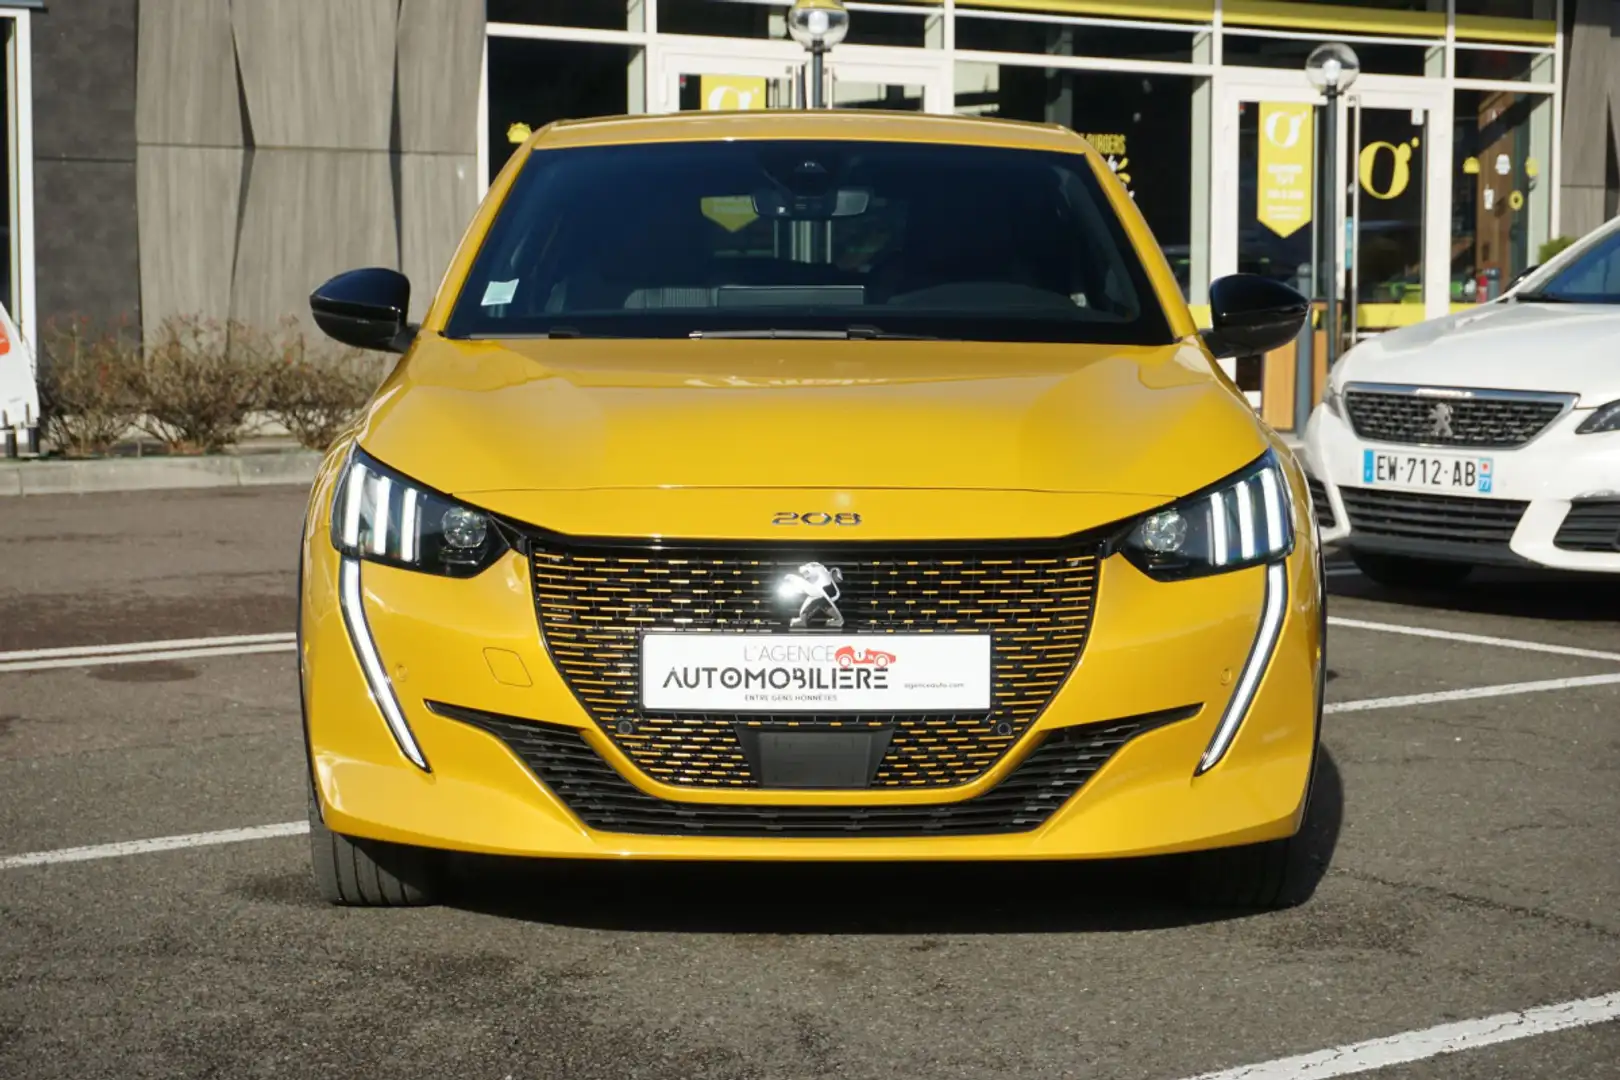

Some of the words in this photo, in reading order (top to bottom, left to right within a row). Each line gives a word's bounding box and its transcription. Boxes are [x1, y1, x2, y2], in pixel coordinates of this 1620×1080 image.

[772, 511, 862, 526] 208
[743, 645, 835, 662] L'AGENCE
[904, 682, 965, 690] agenceauto.com
[744, 694, 769, 702] ENTRE
[771, 694, 793, 702] GENS
